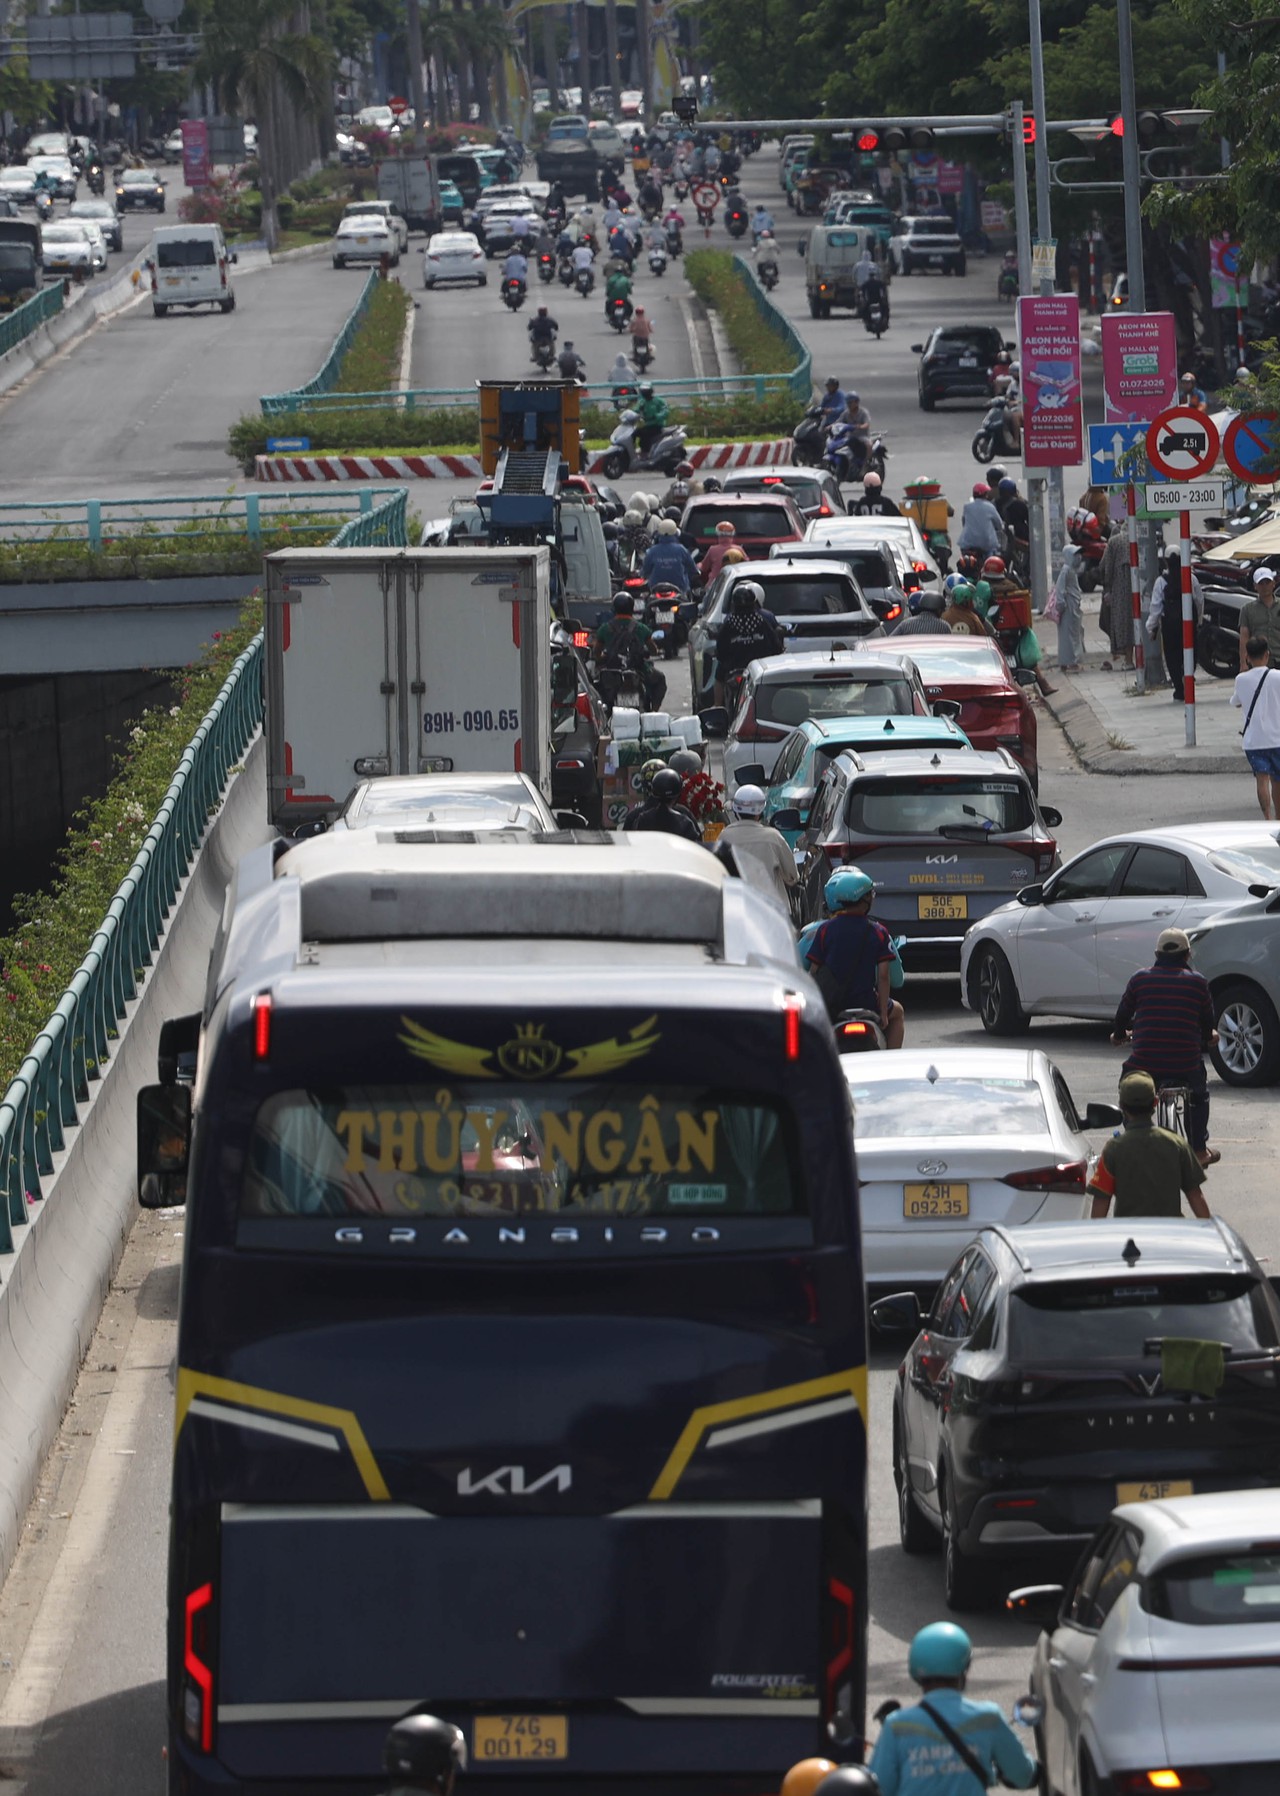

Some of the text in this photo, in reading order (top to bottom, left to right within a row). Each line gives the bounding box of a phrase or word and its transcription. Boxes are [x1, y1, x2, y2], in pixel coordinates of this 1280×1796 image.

[1025, 336, 1078, 345] AEON MALL
[1031, 345, 1051, 355] ĐẾN
[1126, 355, 1154, 366] Grab
[1119, 379, 1165, 388] 01.07.2026
[1031, 415, 1074, 423] 01.07.2026
[1153, 491, 1180, 504] 05:00
[1189, 490, 1216, 503] 23:00
[423, 709, 519, 734] 89H-090.65
[926, 854, 958, 864] KIA
[932, 896, 953, 907] 50E
[336, 1088, 719, 1173] THỦY NGÂN
[922, 1185, 950, 1199] 43H
[911, 1200, 961, 1215] 092.35
[335, 1227, 721, 1243] GRANBIRD
[1088, 1411, 1216, 1427] VINFAST
[457, 1464, 572, 1495] KIA
[711, 1674, 805, 1687] POWERTEC
[502, 1717, 540, 1736] 74G
[484, 1738, 557, 1757] 001.29
